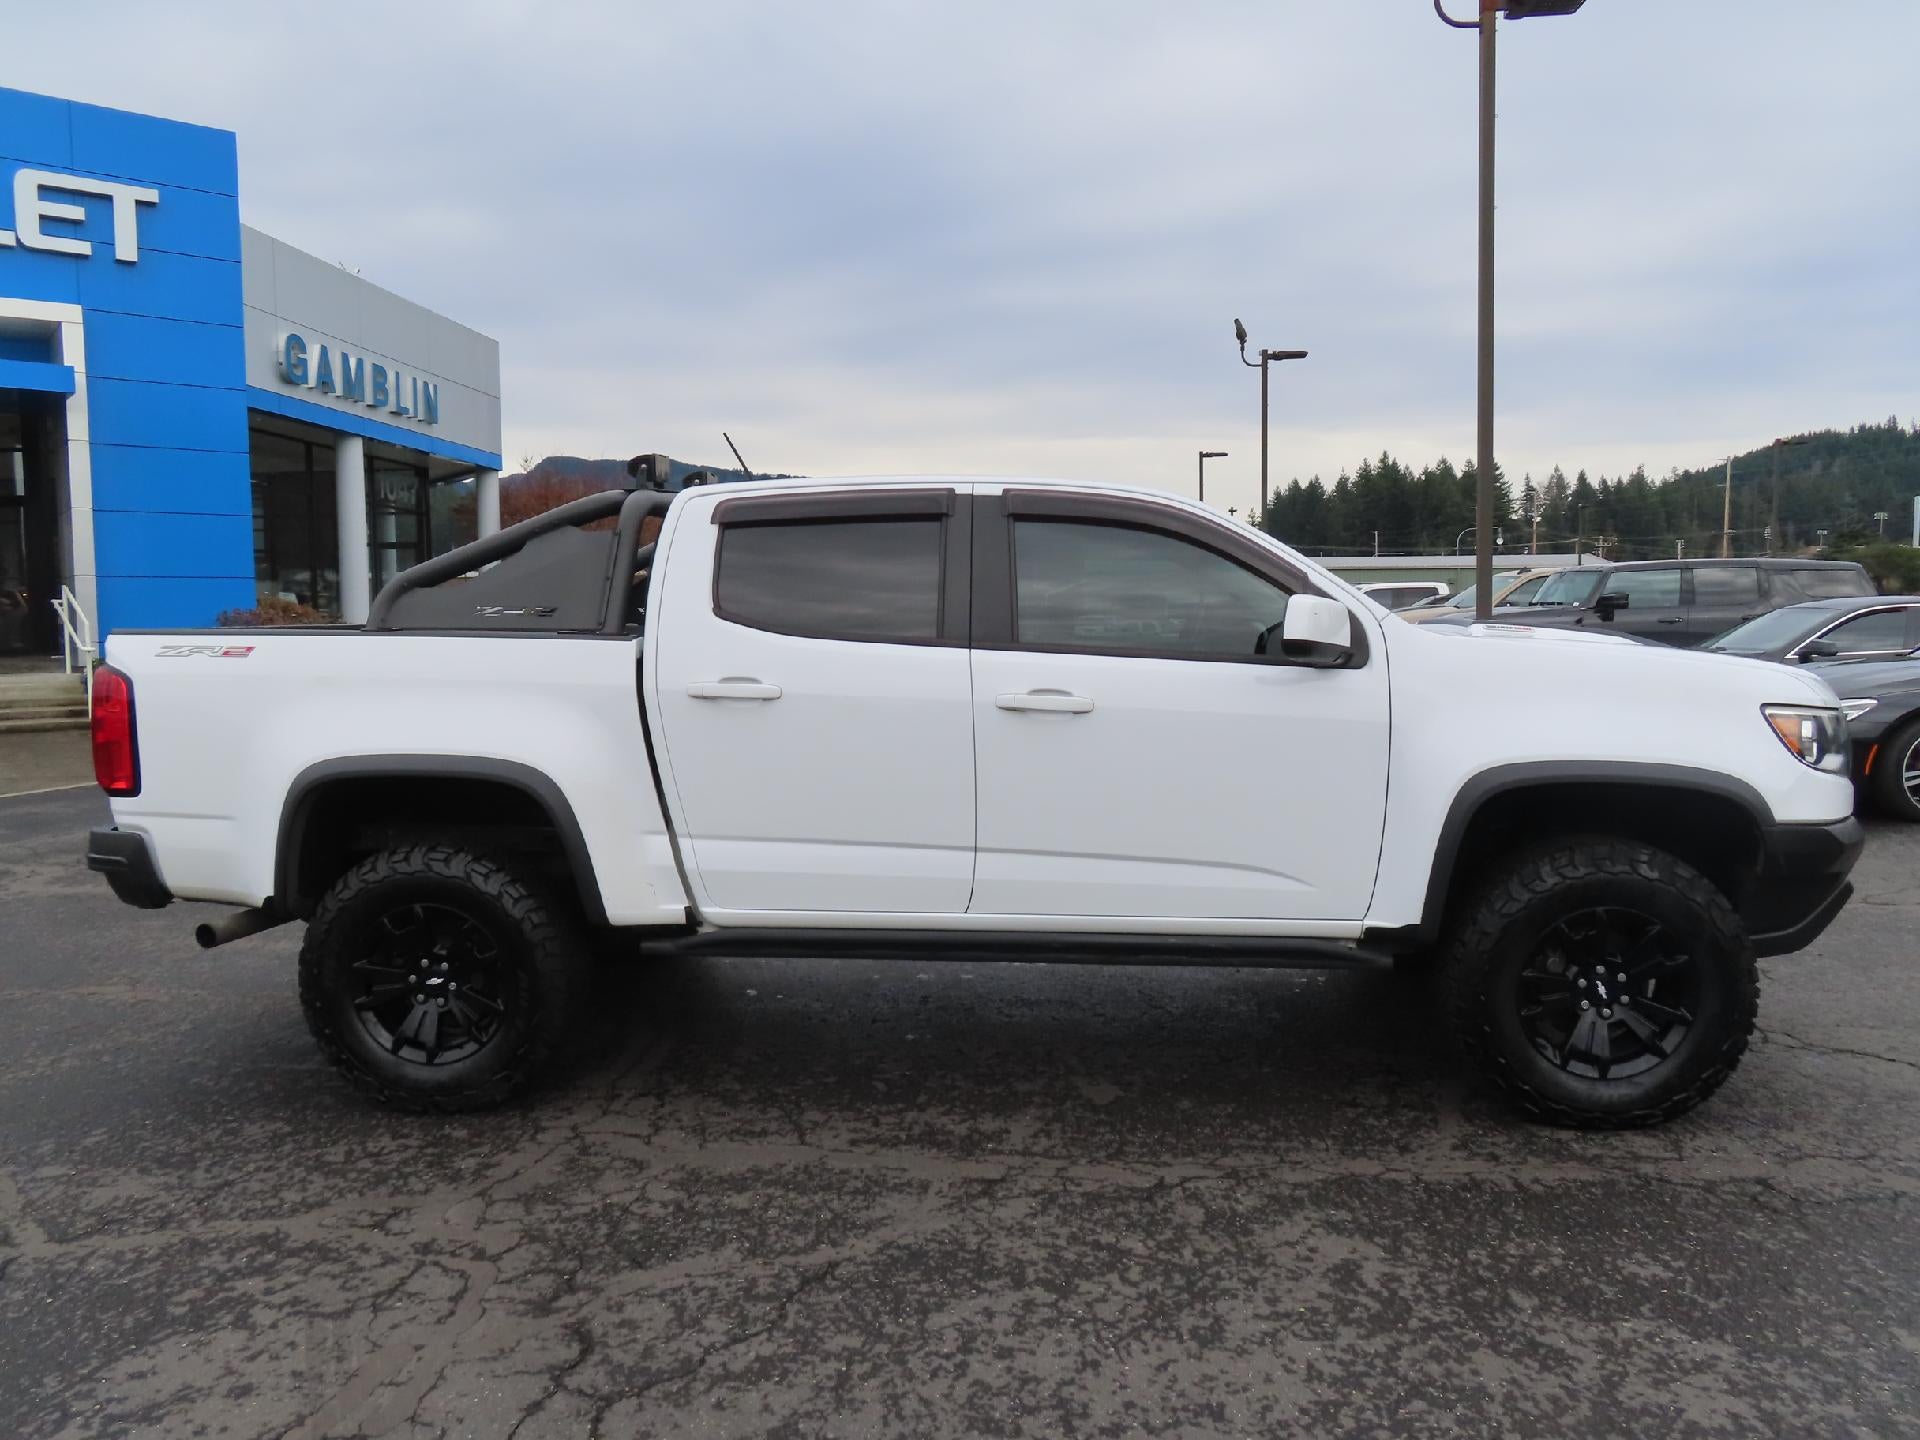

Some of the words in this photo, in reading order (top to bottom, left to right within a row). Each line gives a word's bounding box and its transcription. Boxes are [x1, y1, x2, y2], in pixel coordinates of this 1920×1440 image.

[0, 168, 159, 262] ET
[281, 333, 438, 424] GAMBLIN
[154, 645, 256, 658] ZR2
